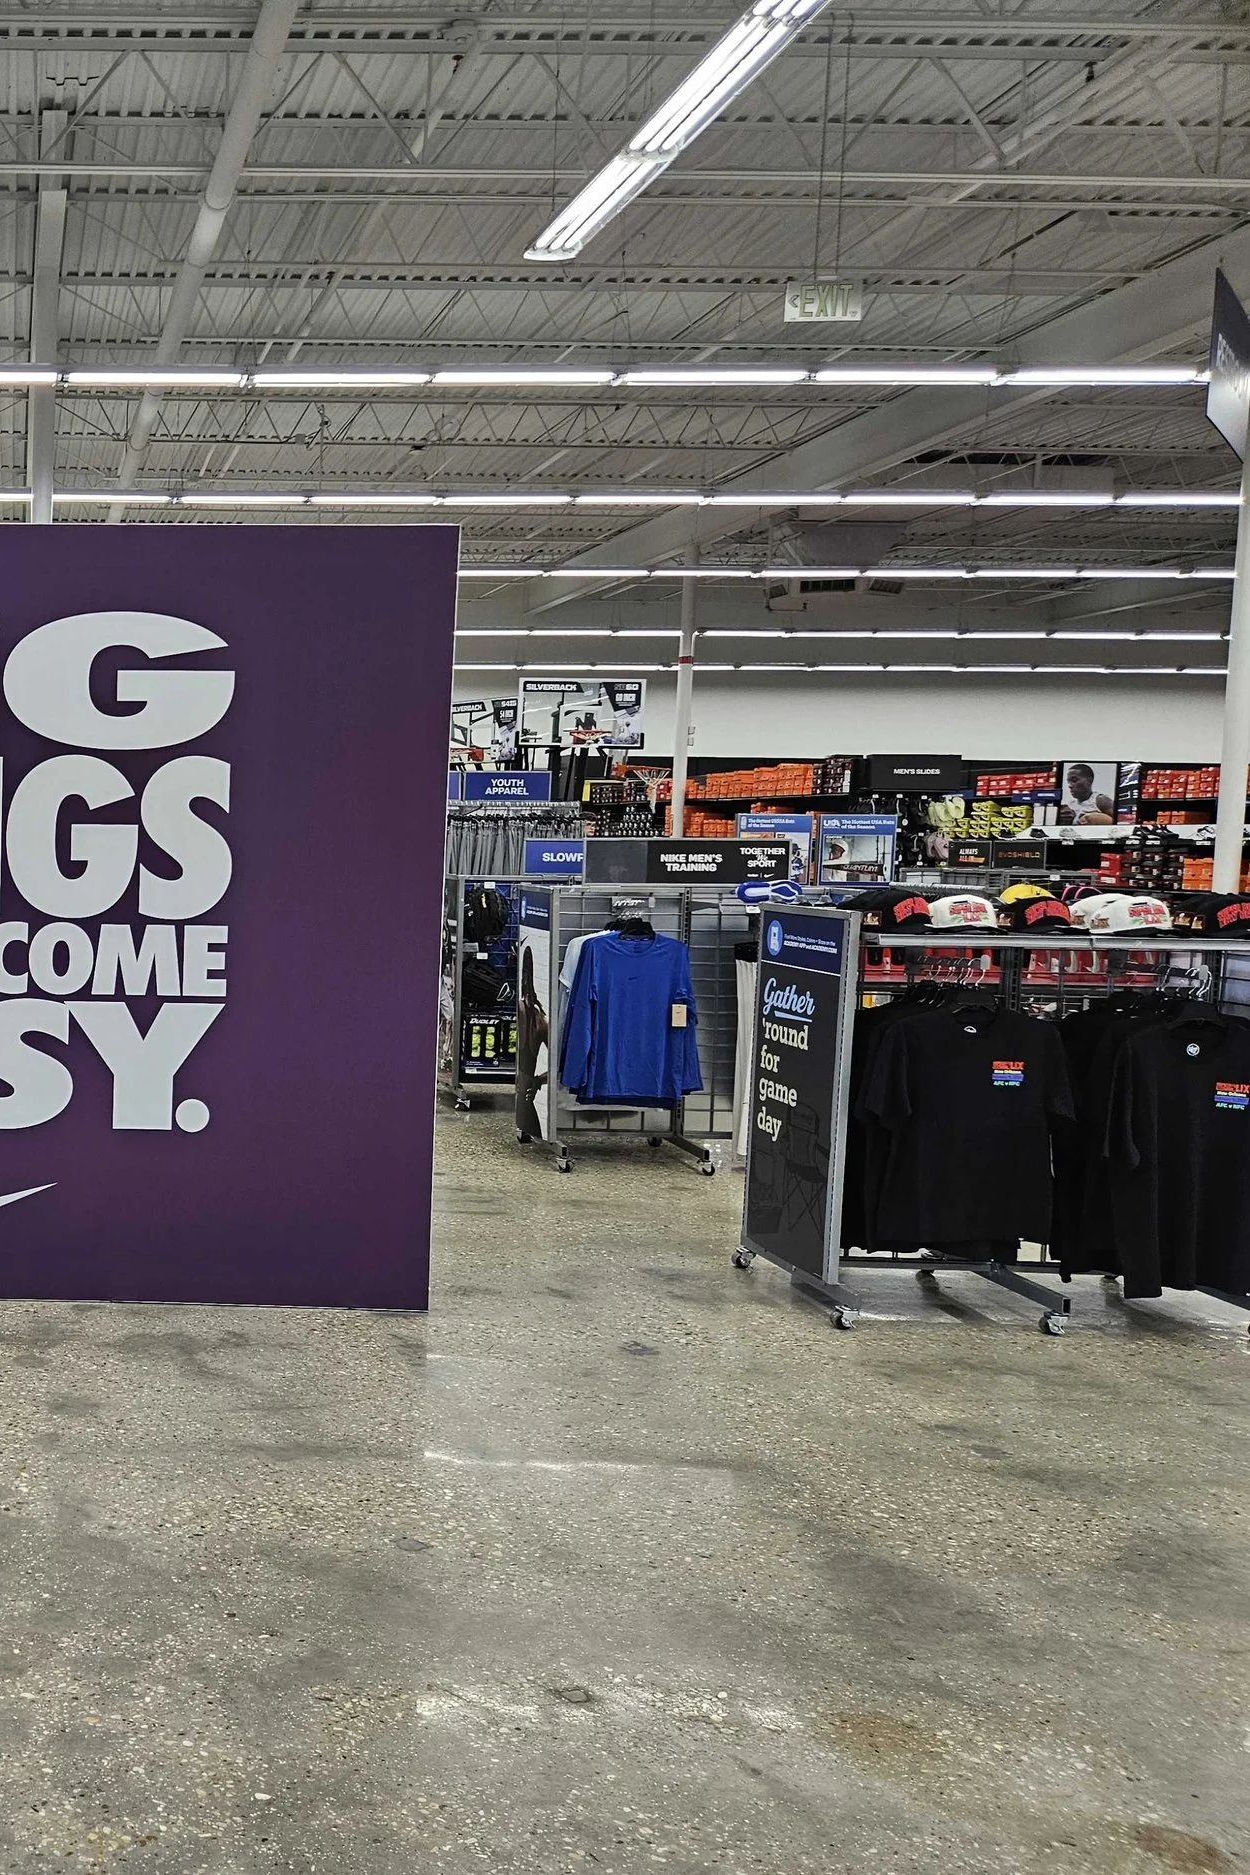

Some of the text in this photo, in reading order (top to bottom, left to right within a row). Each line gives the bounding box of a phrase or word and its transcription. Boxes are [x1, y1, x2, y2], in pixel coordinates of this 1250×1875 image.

[799, 284, 853, 317] EXIT
[526, 683, 577, 691] SILVERBACK
[491, 779, 524, 787] YOUTH
[485, 787, 529, 795] APPAREL
[739, 847, 786, 855] TOGETHER
[660, 854, 723, 863] NIKE MEN'S
[665, 863, 717, 872] TRAINING
[747, 860, 777, 868] SPORT
[763, 977, 816, 1016] Gather
[762, 1018, 809, 1051] 'round
[760, 1045, 780, 1073] for
[759, 1076, 798, 1107] game
[757, 1106, 782, 1142] day
